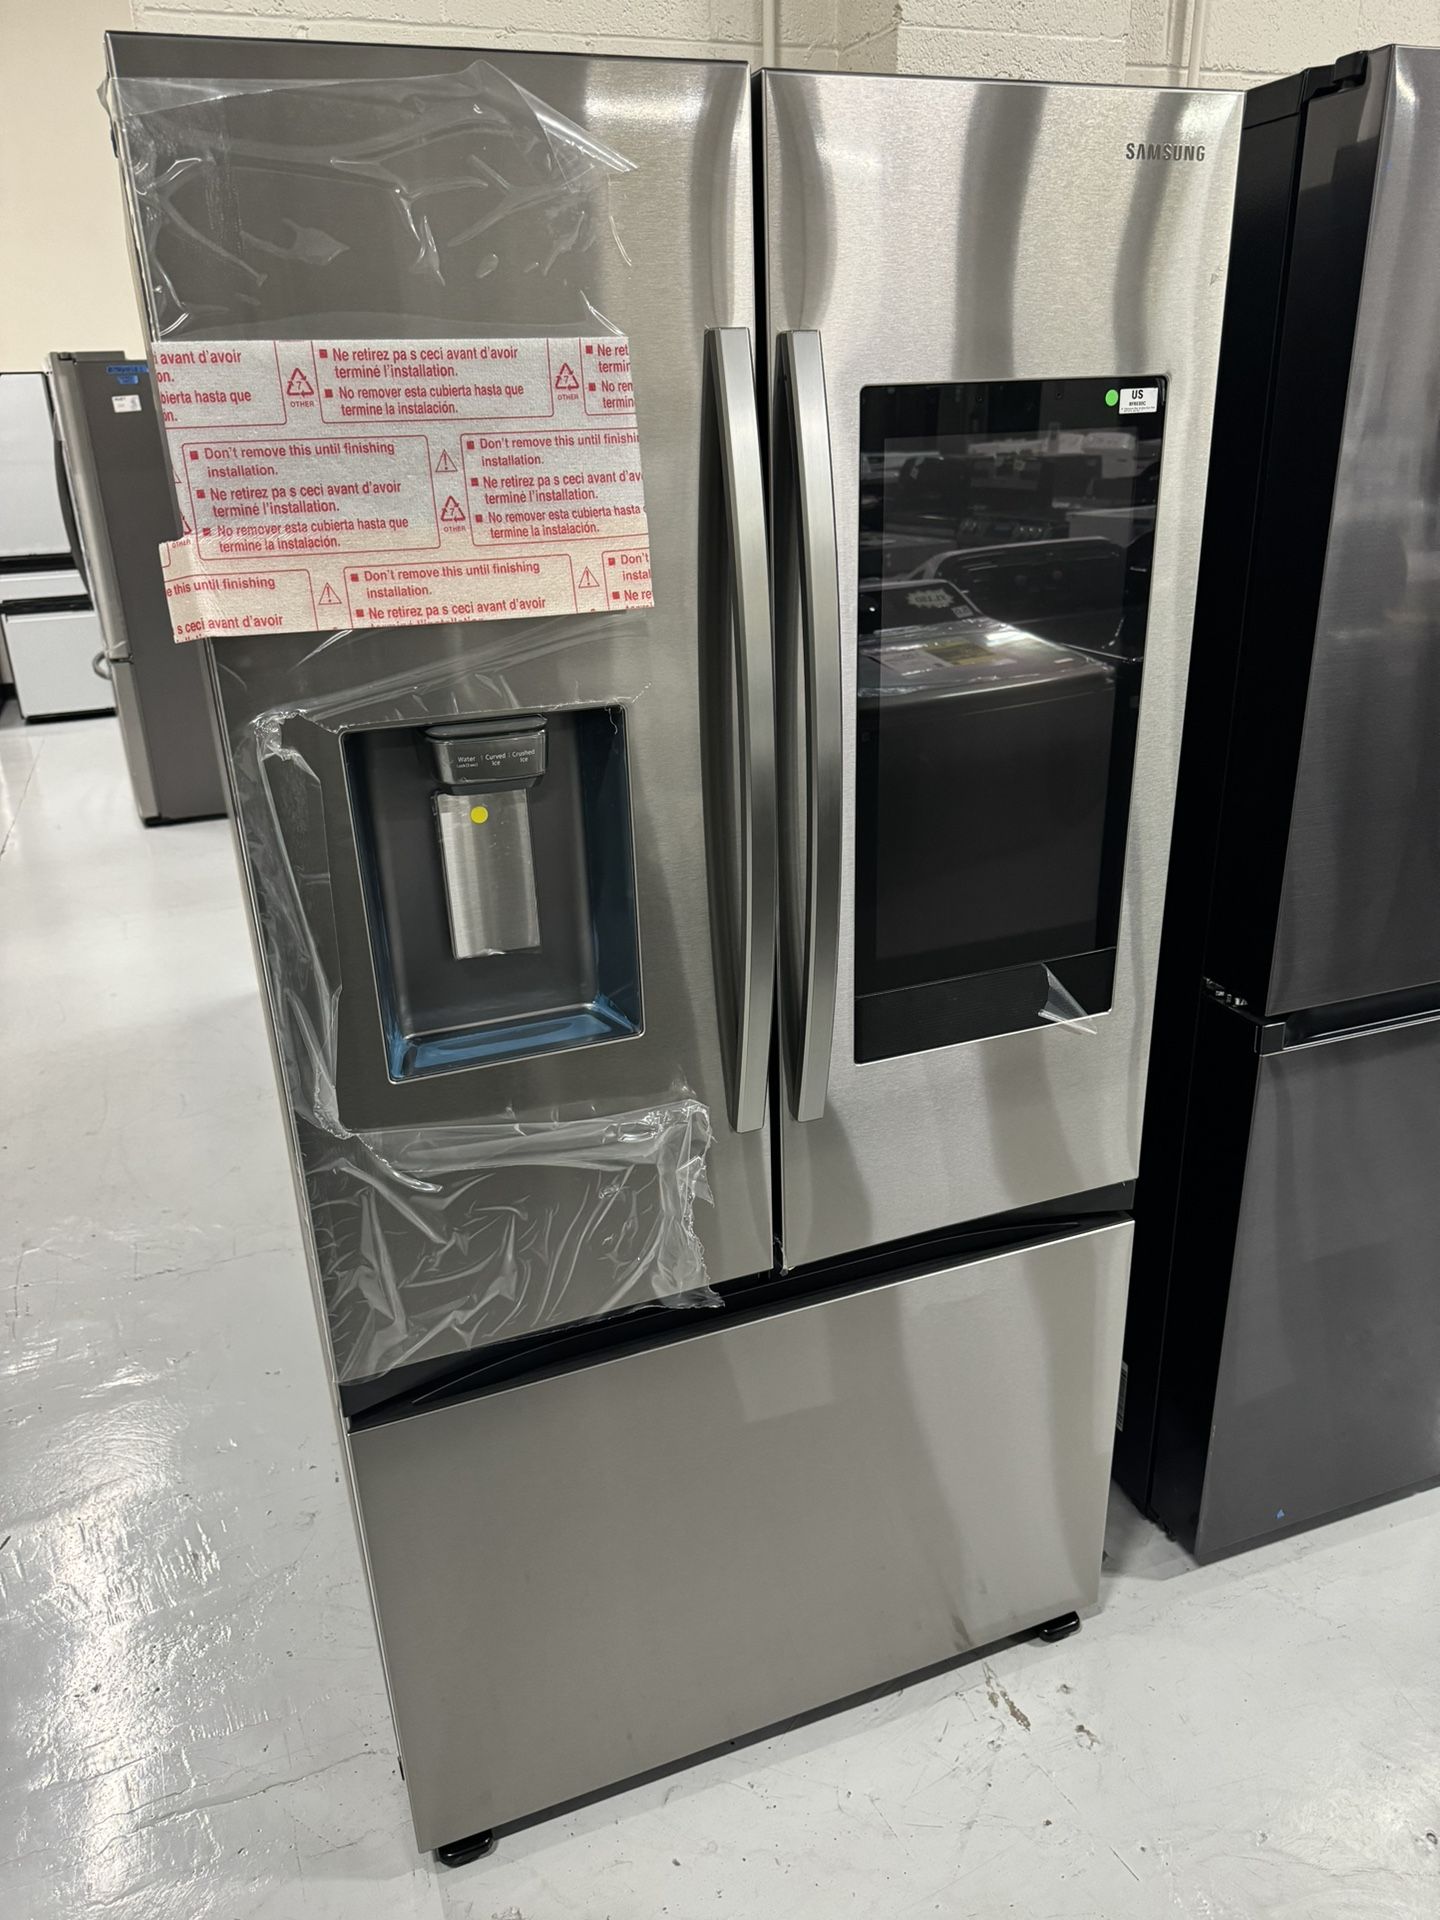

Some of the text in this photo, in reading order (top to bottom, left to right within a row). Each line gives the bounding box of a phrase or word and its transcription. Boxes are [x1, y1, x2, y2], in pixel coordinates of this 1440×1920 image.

[1126, 143, 1205, 161] SAMSUNG
[161, 351, 195, 365] avant
[198, 349, 241, 364] d'avoir
[333, 346, 518, 364] Ne retirez pa s ceci avant d'avoir
[597, 344, 612, 356] Ne
[335, 364, 458, 378] terminé l'installation.
[339, 384, 524, 399] No remover esta cubierta hasta que
[601, 380, 615, 392] No
[194, 390, 227, 403] hasta
[229, 391, 252, 405] que
[1132, 390, 1144, 400] US
[342, 401, 458, 416] termine la instalación.
[480, 438, 509, 449] Don't
[512, 439, 552, 449] remove
[555, 436, 575, 446] this
[578, 434, 601, 445] until
[205, 442, 395, 460] Don't remove this until finishing
[482, 454, 544, 467] installation.
[207, 465, 278, 478] installation.
[483, 476, 498, 488] Ne
[501, 475, 535, 488] retirez
[538, 477, 551, 490] pa
[554, 476, 560, 486] s
[563, 472, 584, 485] ceci
[588, 472, 616, 484] avant
[210, 481, 402, 501] Ne retirez pa s ceci avant d'avoir
[529, 488, 599, 502] l'installation.
[213, 501, 340, 518] terminé l'installation.
[488, 505, 641, 523] No remover esta cubierta hasta
[237, 525, 281, 536] remover
[311, 519, 354, 531] cubierta
[357, 517, 385, 529] hasta
[389, 518, 409, 530] que
[490, 522, 600, 539] termine la instalación.
[219, 540, 261, 553] termine
[278, 536, 341, 549] instalación.
[621, 552, 649, 565] Don't
[364, 561, 541, 582] Don't remove this until finishing
[174, 583, 191, 595] this
[193, 579, 219, 591] until
[223, 577, 276, 590] finishing
[366, 585, 433, 599] installation.
[624, 590, 639, 601] Ne
[368, 597, 546, 619] Ne retirez pa s ceci avant d'avoir
[185, 618, 205, 633] ceci
[208, 617, 239, 629] avant
[242, 613, 283, 628] d'avoir
[485, 753, 506, 761] Curved
[512, 749, 536, 757] Crushed
